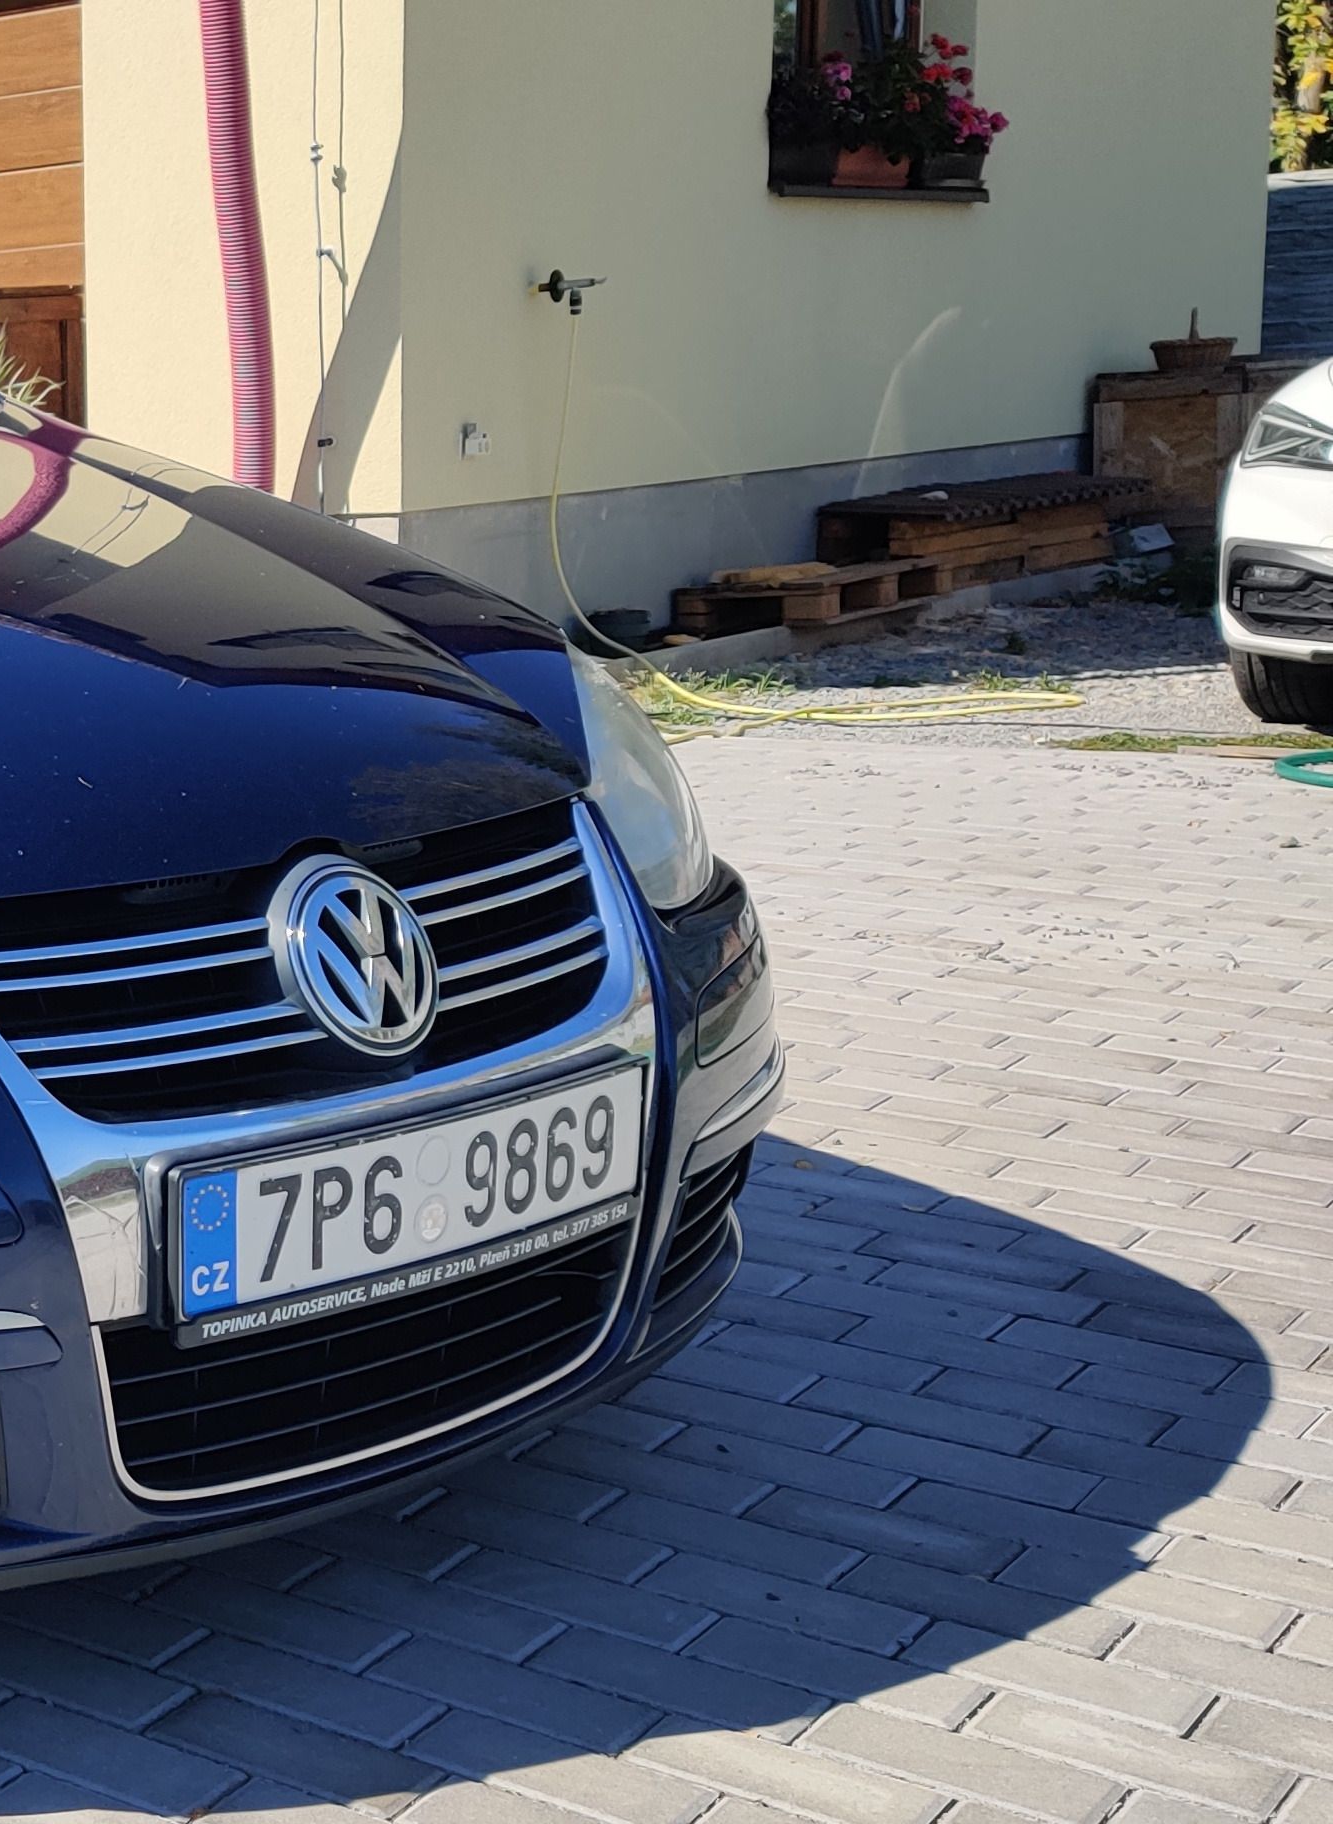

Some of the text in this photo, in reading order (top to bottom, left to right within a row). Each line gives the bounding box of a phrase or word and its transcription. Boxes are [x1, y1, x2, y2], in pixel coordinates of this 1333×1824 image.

[258, 1095, 615, 1284] 7P6 9869
[190, 1261, 230, 1296] CZ
[202, 1311, 267, 1339] TOPINKA
[269, 1286, 367, 1325] AUTOSERVICE,
[370, 1277, 406, 1299] Nade
[433, 1267, 443, 1282] E
[444, 1257, 477, 1280] 2210,
[479, 1246, 511, 1270] Plzeň
[511, 1238, 533, 1258] 318
[534, 1232, 550, 1250] 00,
[552, 1224, 569, 1244] tel.
[570, 1217, 591, 1237] 377
[590, 1211, 609, 1230] 385
[610, 1202, 629, 1222] 154
